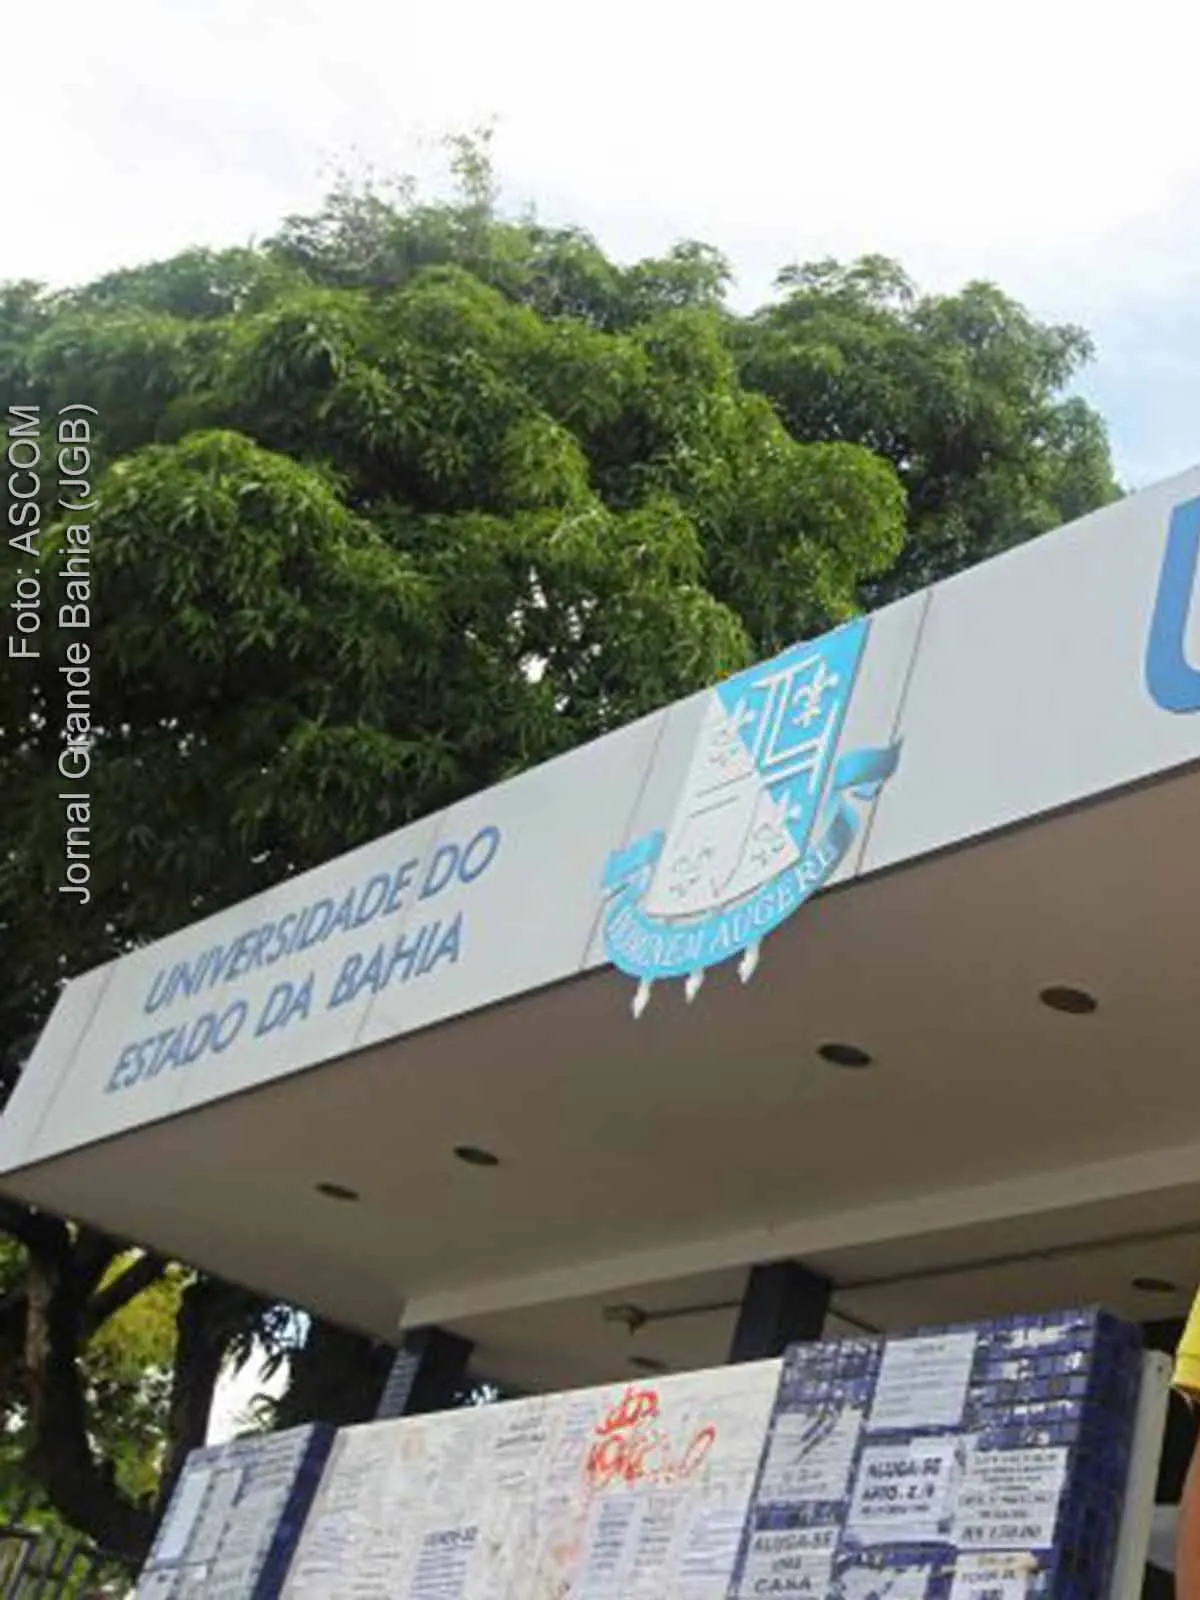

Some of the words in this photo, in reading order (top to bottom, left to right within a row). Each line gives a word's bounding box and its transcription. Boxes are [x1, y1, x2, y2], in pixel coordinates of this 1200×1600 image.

[106, 1002, 249, 1093] ESTADO
[255, 972, 316, 1039] DA
[327, 911, 463, 1010] BAHIA
[144, 860, 417, 1014] UNIVERSIDADE
[419, 825, 501, 902] DO
